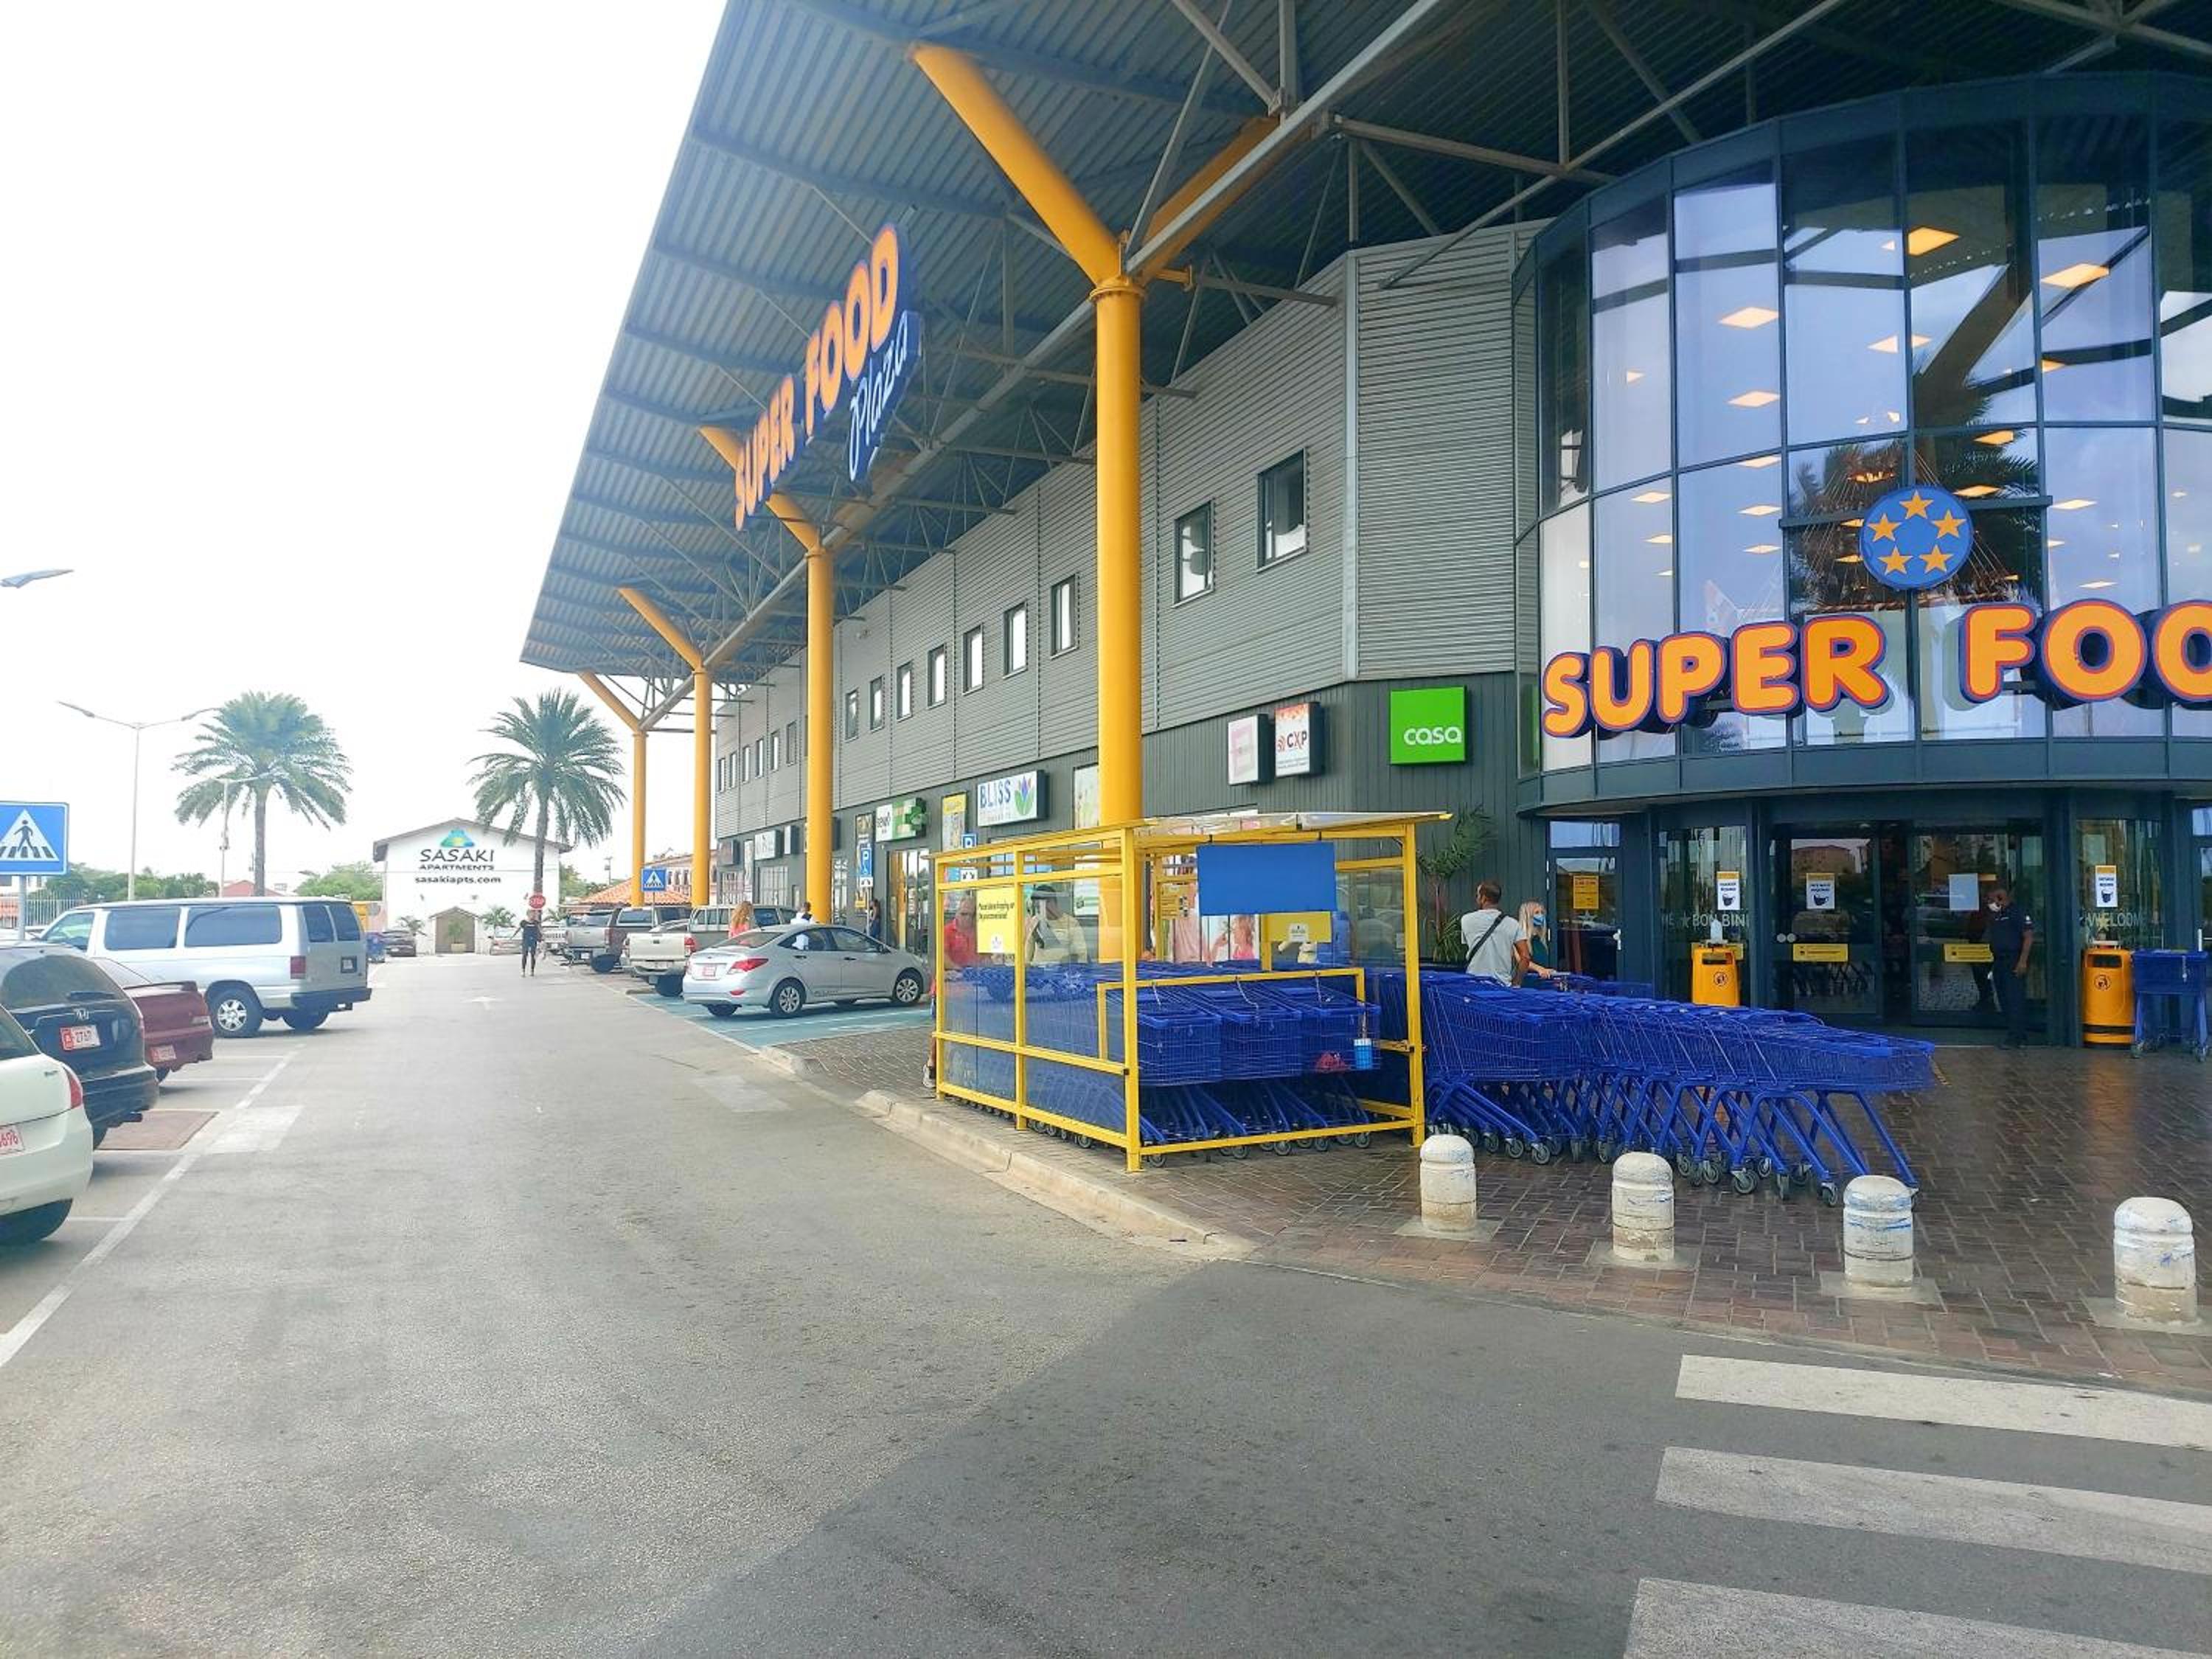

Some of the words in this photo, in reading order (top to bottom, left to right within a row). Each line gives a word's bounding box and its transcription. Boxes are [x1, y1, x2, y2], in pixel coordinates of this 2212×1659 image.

[734, 372, 795, 532] SUPER
[804, 223, 900, 438] FOOD
[849, 310, 908, 482] Plaza
[1543, 613, 1891, 738] SUPER
[1287, 731, 1308, 750] CXP
[1403, 726, 1463, 746] casa
[980, 779, 1011, 809] BLISS
[419, 849, 495, 862] SASAKI
[415, 875, 501, 885] sasakiapts.com
